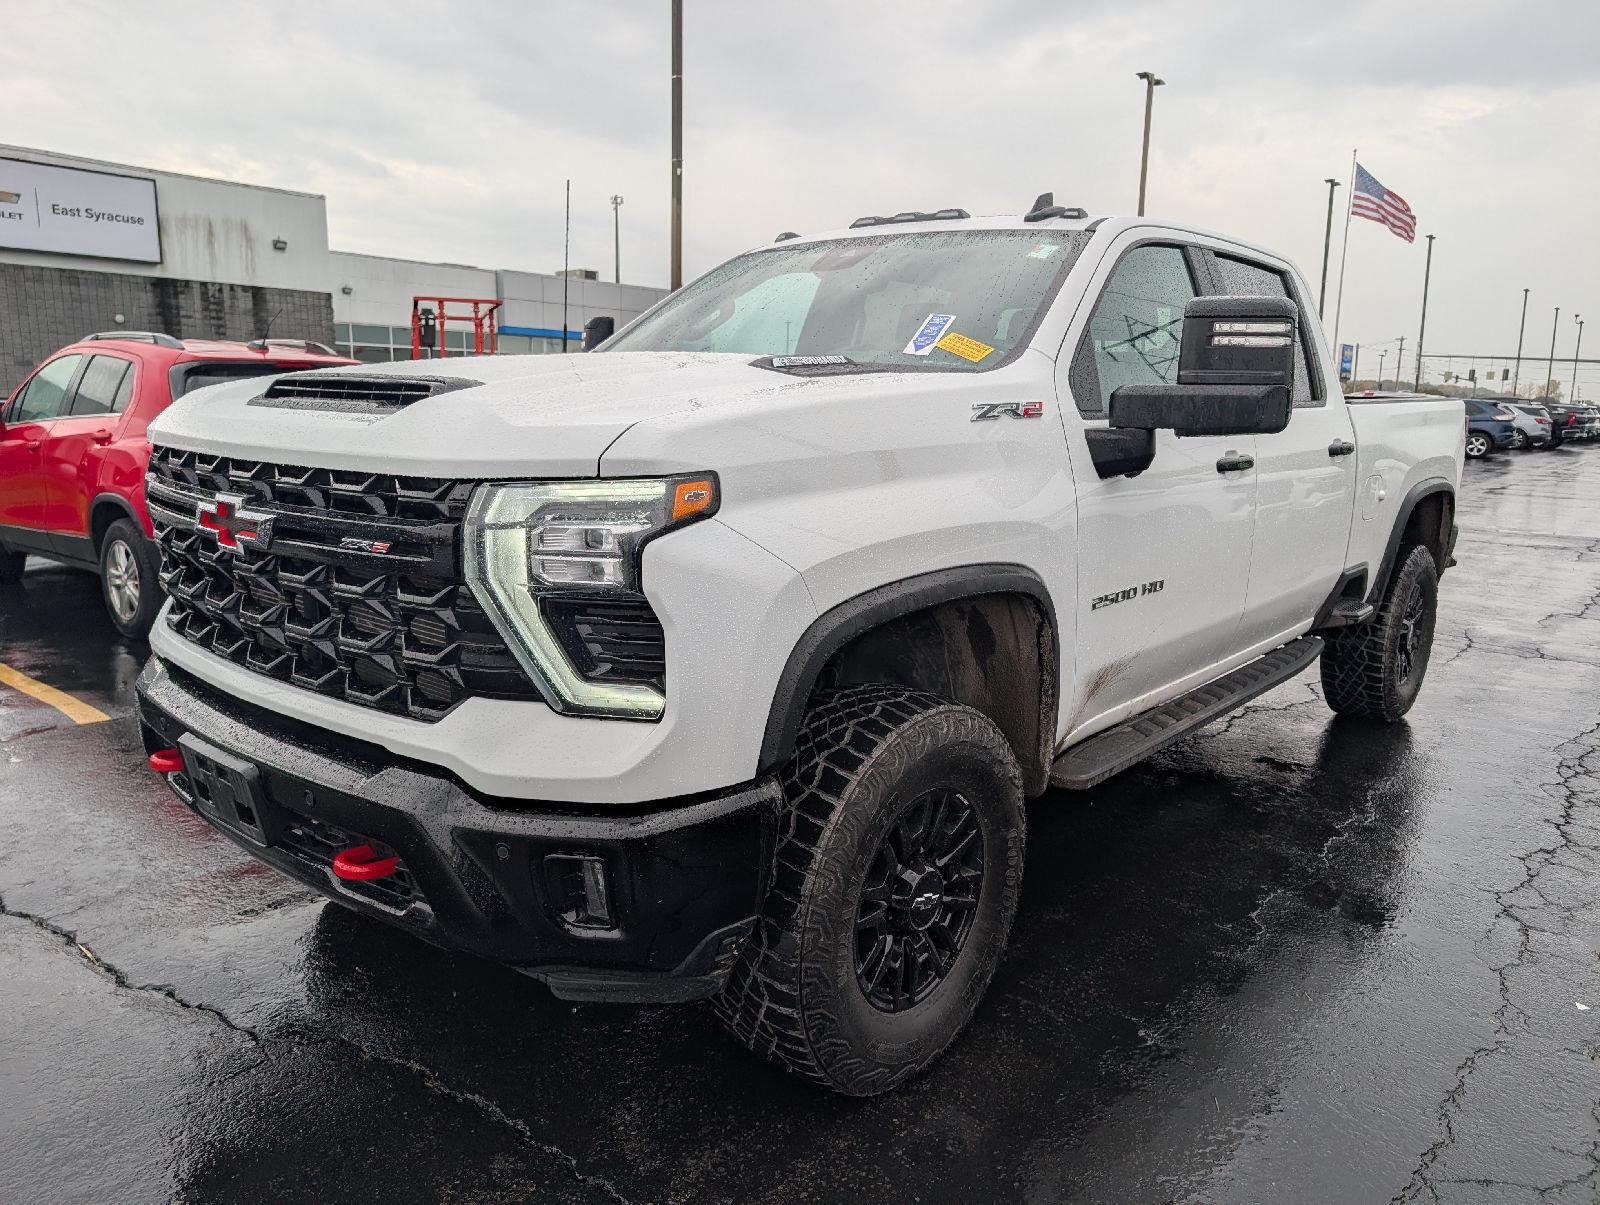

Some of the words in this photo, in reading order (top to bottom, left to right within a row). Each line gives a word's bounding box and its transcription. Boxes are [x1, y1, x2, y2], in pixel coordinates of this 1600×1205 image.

[51, 203, 82, 218] East
[85, 207, 146, 226] Syracuse
[970, 401, 1043, 422] ZR2
[339, 537, 391, 553] ZR2
[1091, 586, 1138, 611] 2500
[1141, 579, 1165, 596] HD
